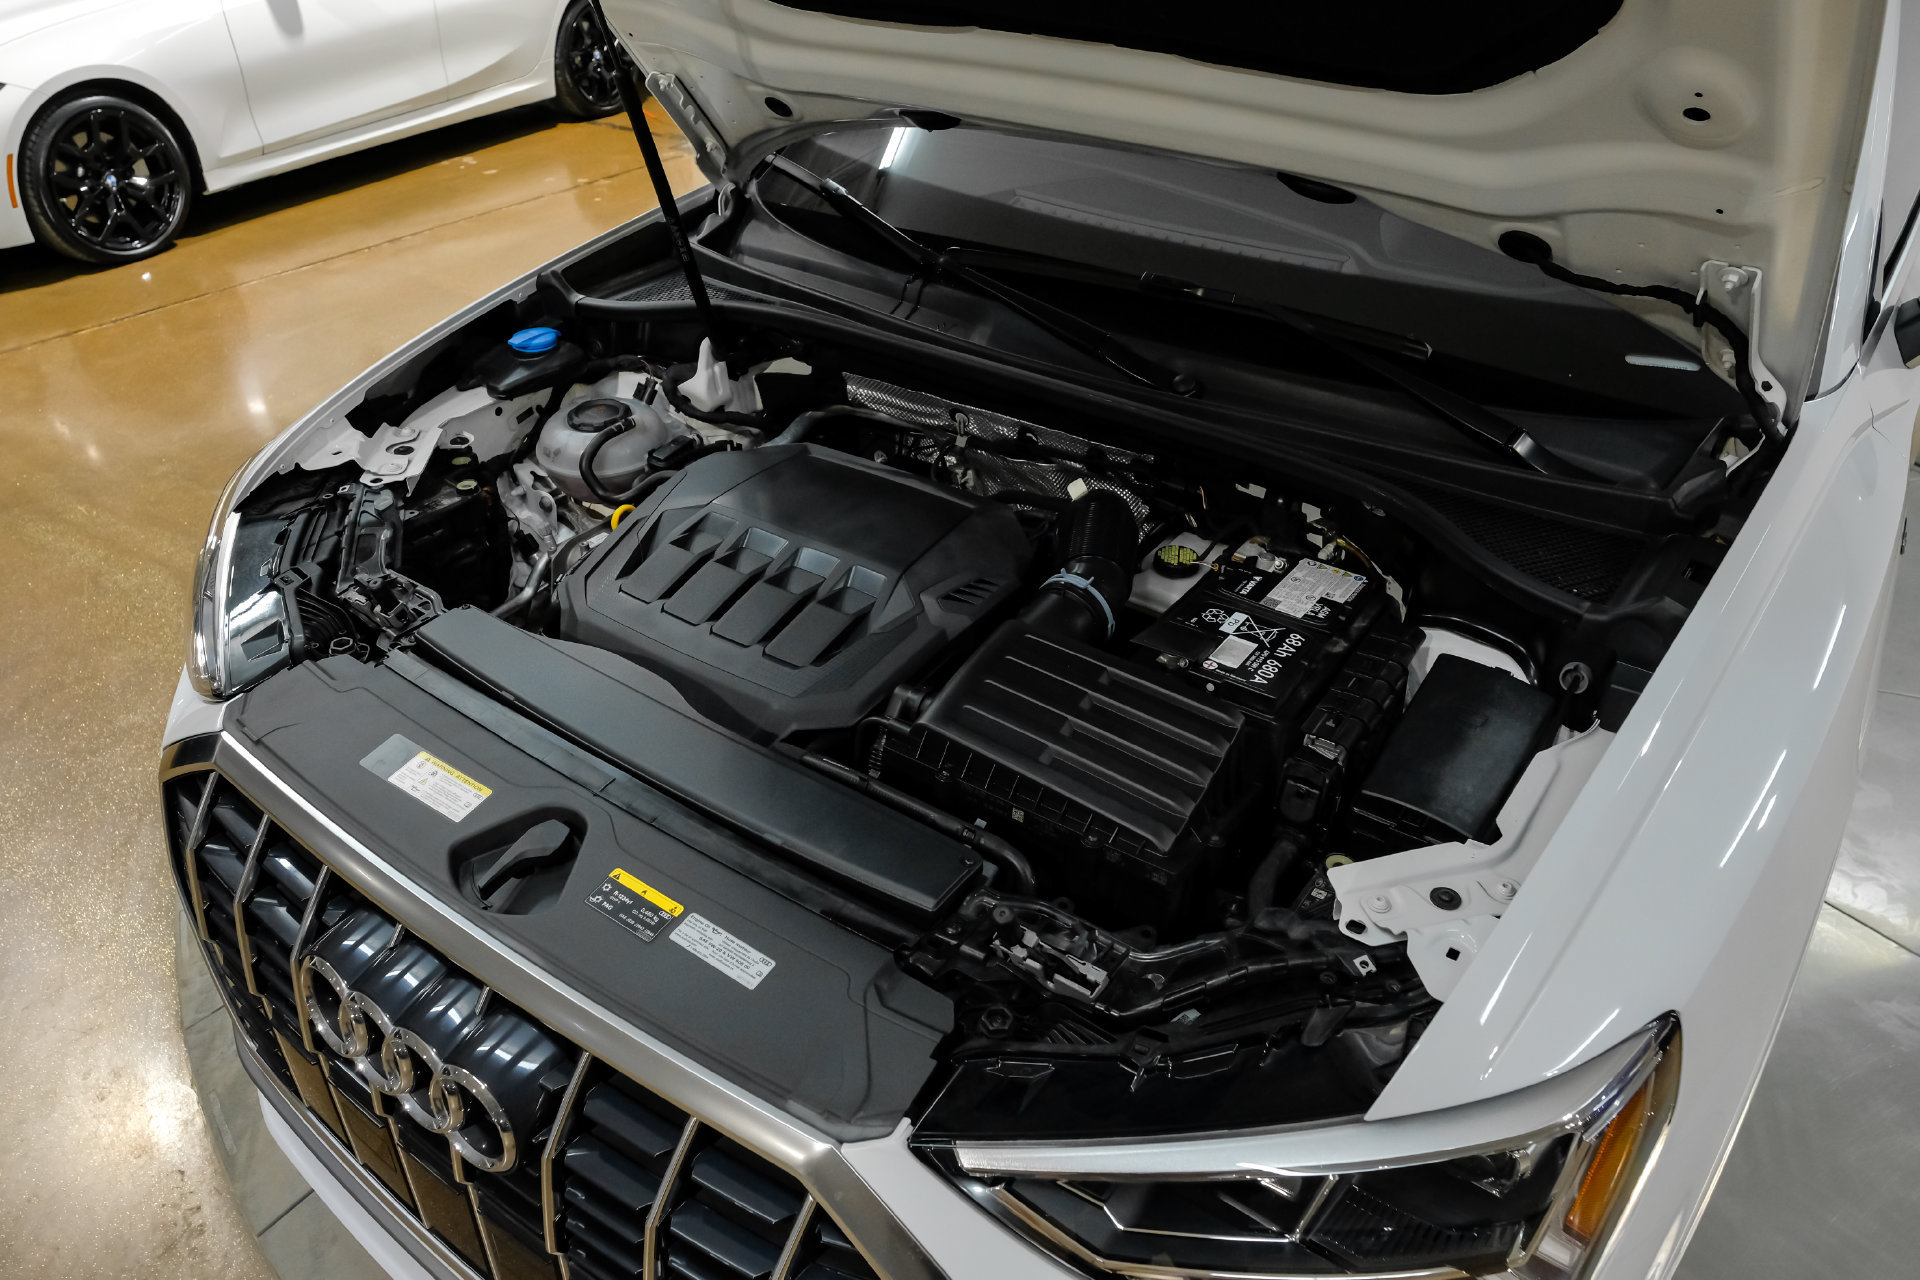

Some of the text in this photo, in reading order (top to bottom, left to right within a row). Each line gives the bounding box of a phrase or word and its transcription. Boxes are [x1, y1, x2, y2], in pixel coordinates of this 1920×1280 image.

[1276, 633, 1306, 658] 68Ah
[1250, 659, 1286, 685] 680A
[431, 761, 454, 775] WARNING
[456, 775, 483, 791] ATTENTION
[602, 901, 613, 910] PAG
